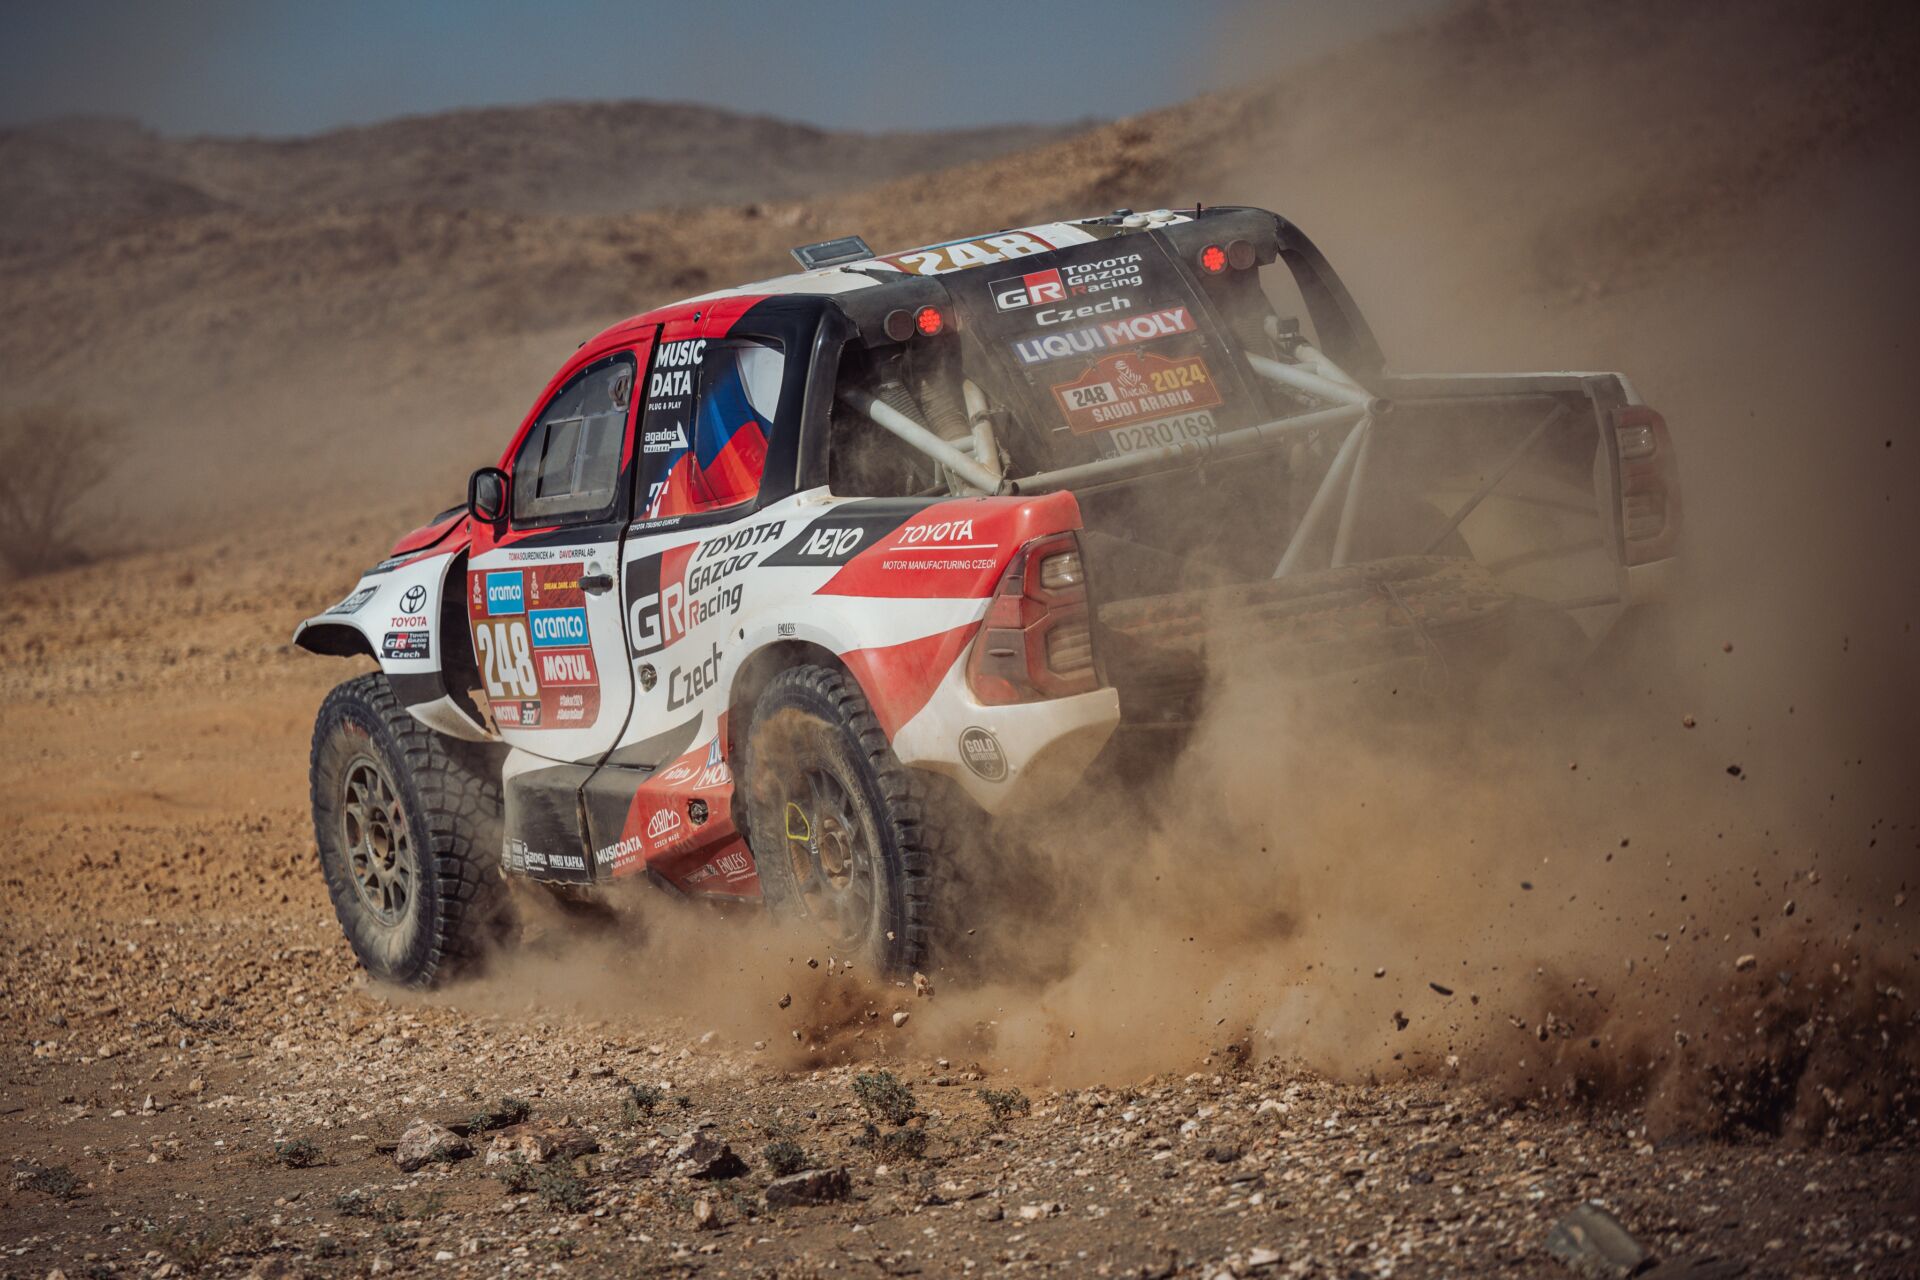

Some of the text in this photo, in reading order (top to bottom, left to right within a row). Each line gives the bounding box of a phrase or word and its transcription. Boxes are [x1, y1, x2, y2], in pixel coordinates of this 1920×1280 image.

[899, 233, 1052, 277] 248
[1061, 253, 1143, 277] TOYOTA
[1066, 264, 1140, 287] GAZOO
[1070, 275, 1143, 298] Racing
[997, 283, 1064, 310] GR
[1035, 296, 1132, 326] Czech
[1016, 309, 1187, 363] LIQUI MOLY
[655, 340, 706, 368] MUSIC
[650, 371, 692, 397] DATA
[1150, 364, 1206, 393] 2024
[648, 402, 662, 411] PLUG
[668, 401, 682, 410] PLAY
[1072, 386, 1108, 408] 248
[1092, 389, 1195, 422] SAUDI ARABIA
[645, 428, 678, 444] agados
[696, 519, 788, 562] TOYOTA
[898, 520, 973, 543] TOYOTA
[689, 551, 759, 595] GAZOO
[882, 558, 997, 570] MOTOR MANUFACTURING CZECH
[489, 585, 521, 601] aramco
[630, 582, 686, 651] GR
[689, 583, 744, 630] Racing
[391, 616, 427, 628] TOYOTA
[534, 616, 584, 639] aramco
[385, 638, 407, 649] GR
[391, 650, 420, 658] Czech
[476, 622, 538, 697] 248
[543, 655, 591, 681] MOTUL
[494, 705, 520, 721] MOTUL
[651, 808, 675, 834] PRIM
[596, 836, 642, 865] MUSICDATA
[654, 838, 668, 849] CZECH
[548, 854, 585, 868] PNEU KAFKA
[716, 852, 747, 874] ENDLESS
